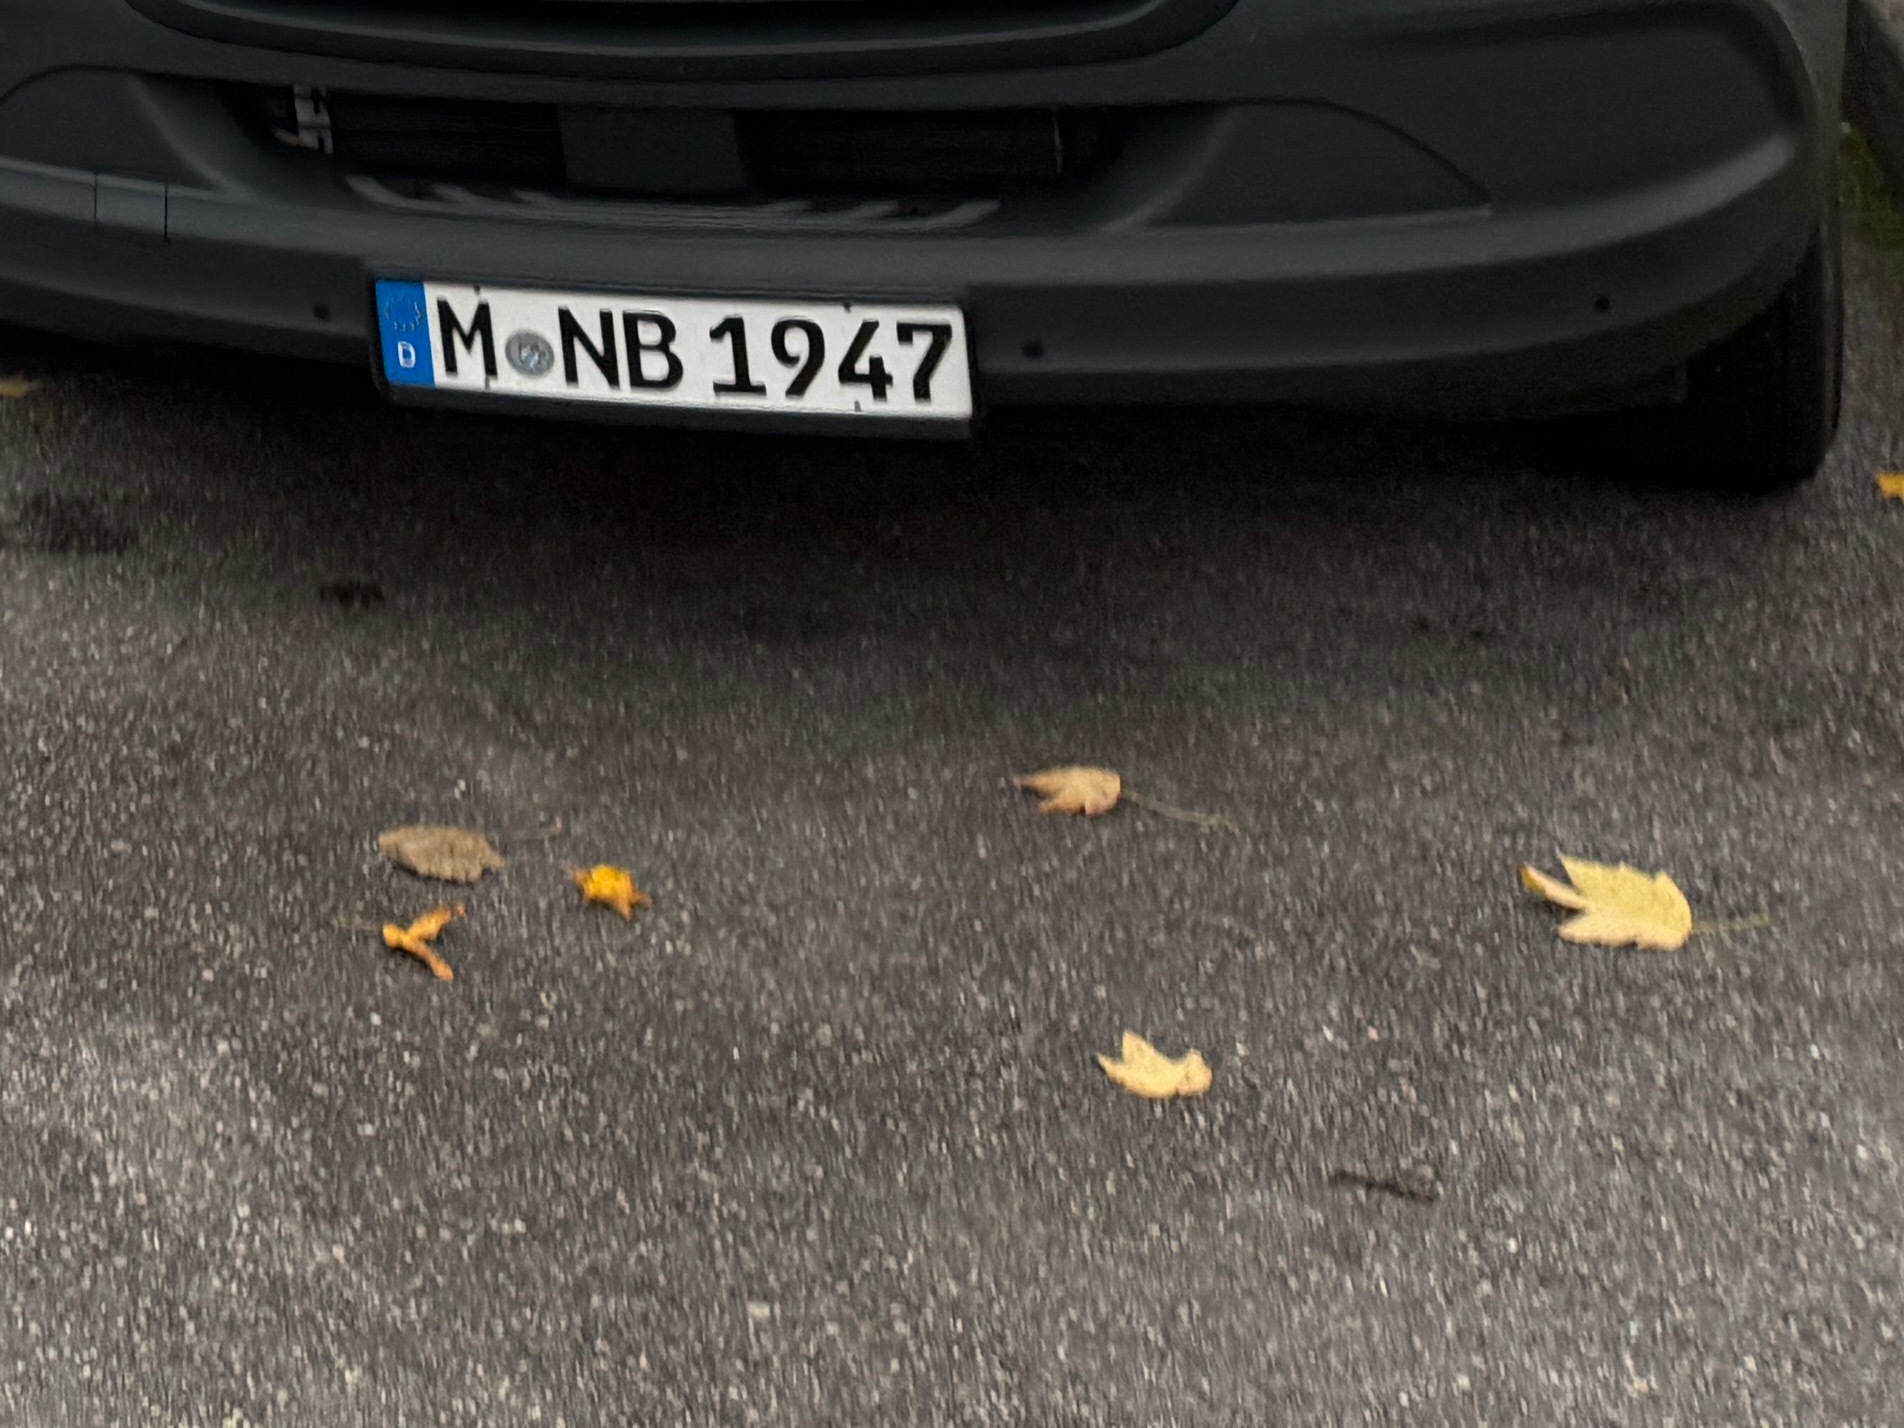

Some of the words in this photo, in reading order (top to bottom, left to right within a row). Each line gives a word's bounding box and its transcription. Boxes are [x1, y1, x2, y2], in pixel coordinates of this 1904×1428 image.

[437, 297, 497, 378] M
[558, 305, 684, 392] NB
[709, 317, 953, 403] 1947
